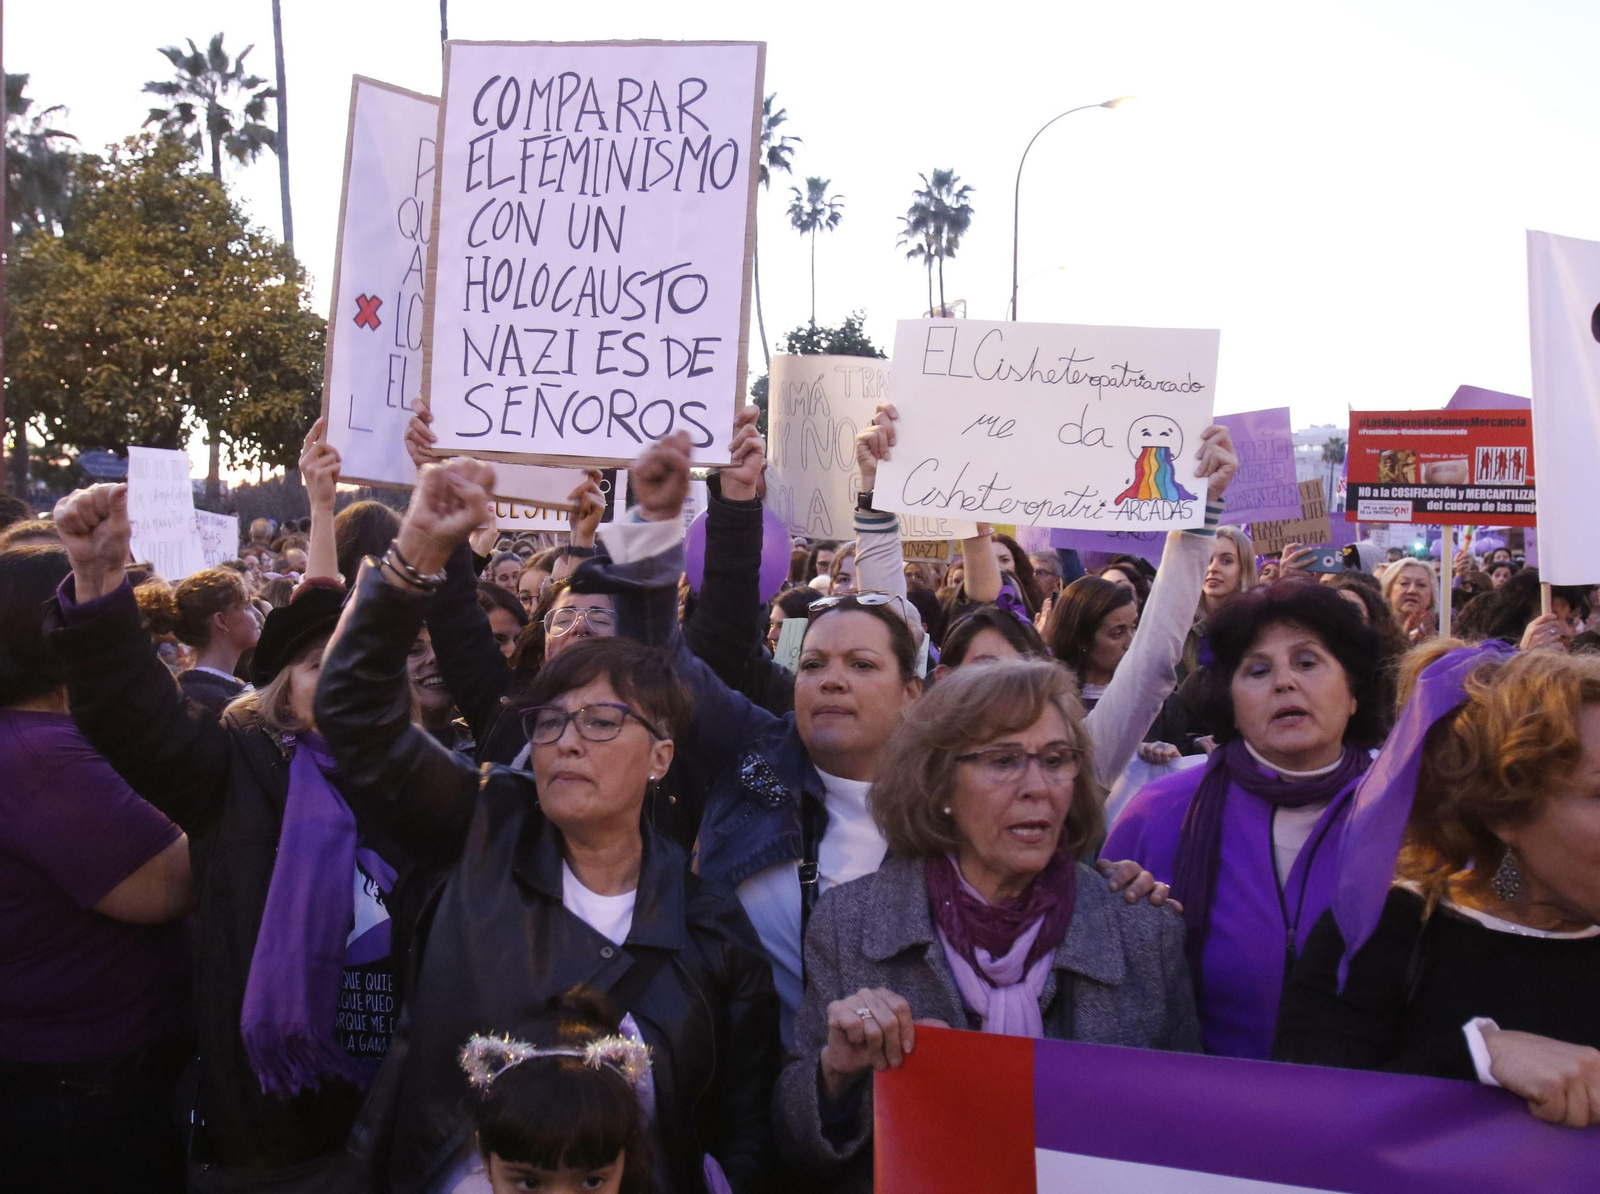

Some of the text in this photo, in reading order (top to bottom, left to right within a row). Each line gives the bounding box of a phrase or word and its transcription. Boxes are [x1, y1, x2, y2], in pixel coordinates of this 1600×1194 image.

[473, 71, 709, 133] COMPARAR
[465, 129, 739, 197] EL FEMINISMO
[467, 198, 626, 254] CON UN
[463, 256, 709, 324] HOLOCAUSTO
[463, 325, 722, 379] NAZI ES DE
[923, 326, 1206, 401] EL Cisheteropatriarcado
[455, 382, 715, 448] SEÑOROS
[961, 403, 1114, 448] me da
[801, 416, 858, 472] NO
[1358, 486, 1371, 498] NO
[1373, 488, 1379, 498] a
[1381, 487, 1390, 498] la
[1391, 486, 1457, 499] COSIFICACIÓN
[1458, 489, 1464, 500] y
[1465, 488, 1535, 500] MERCANTILIZA
[1427, 501, 1443, 511] del
[1444, 502, 1480, 512] cuerpo
[1481, 501, 1495, 512] de
[1497, 501, 1513, 512] las
[338, 992, 364, 1011] QUE
[370, 1016, 386, 1033] ME
